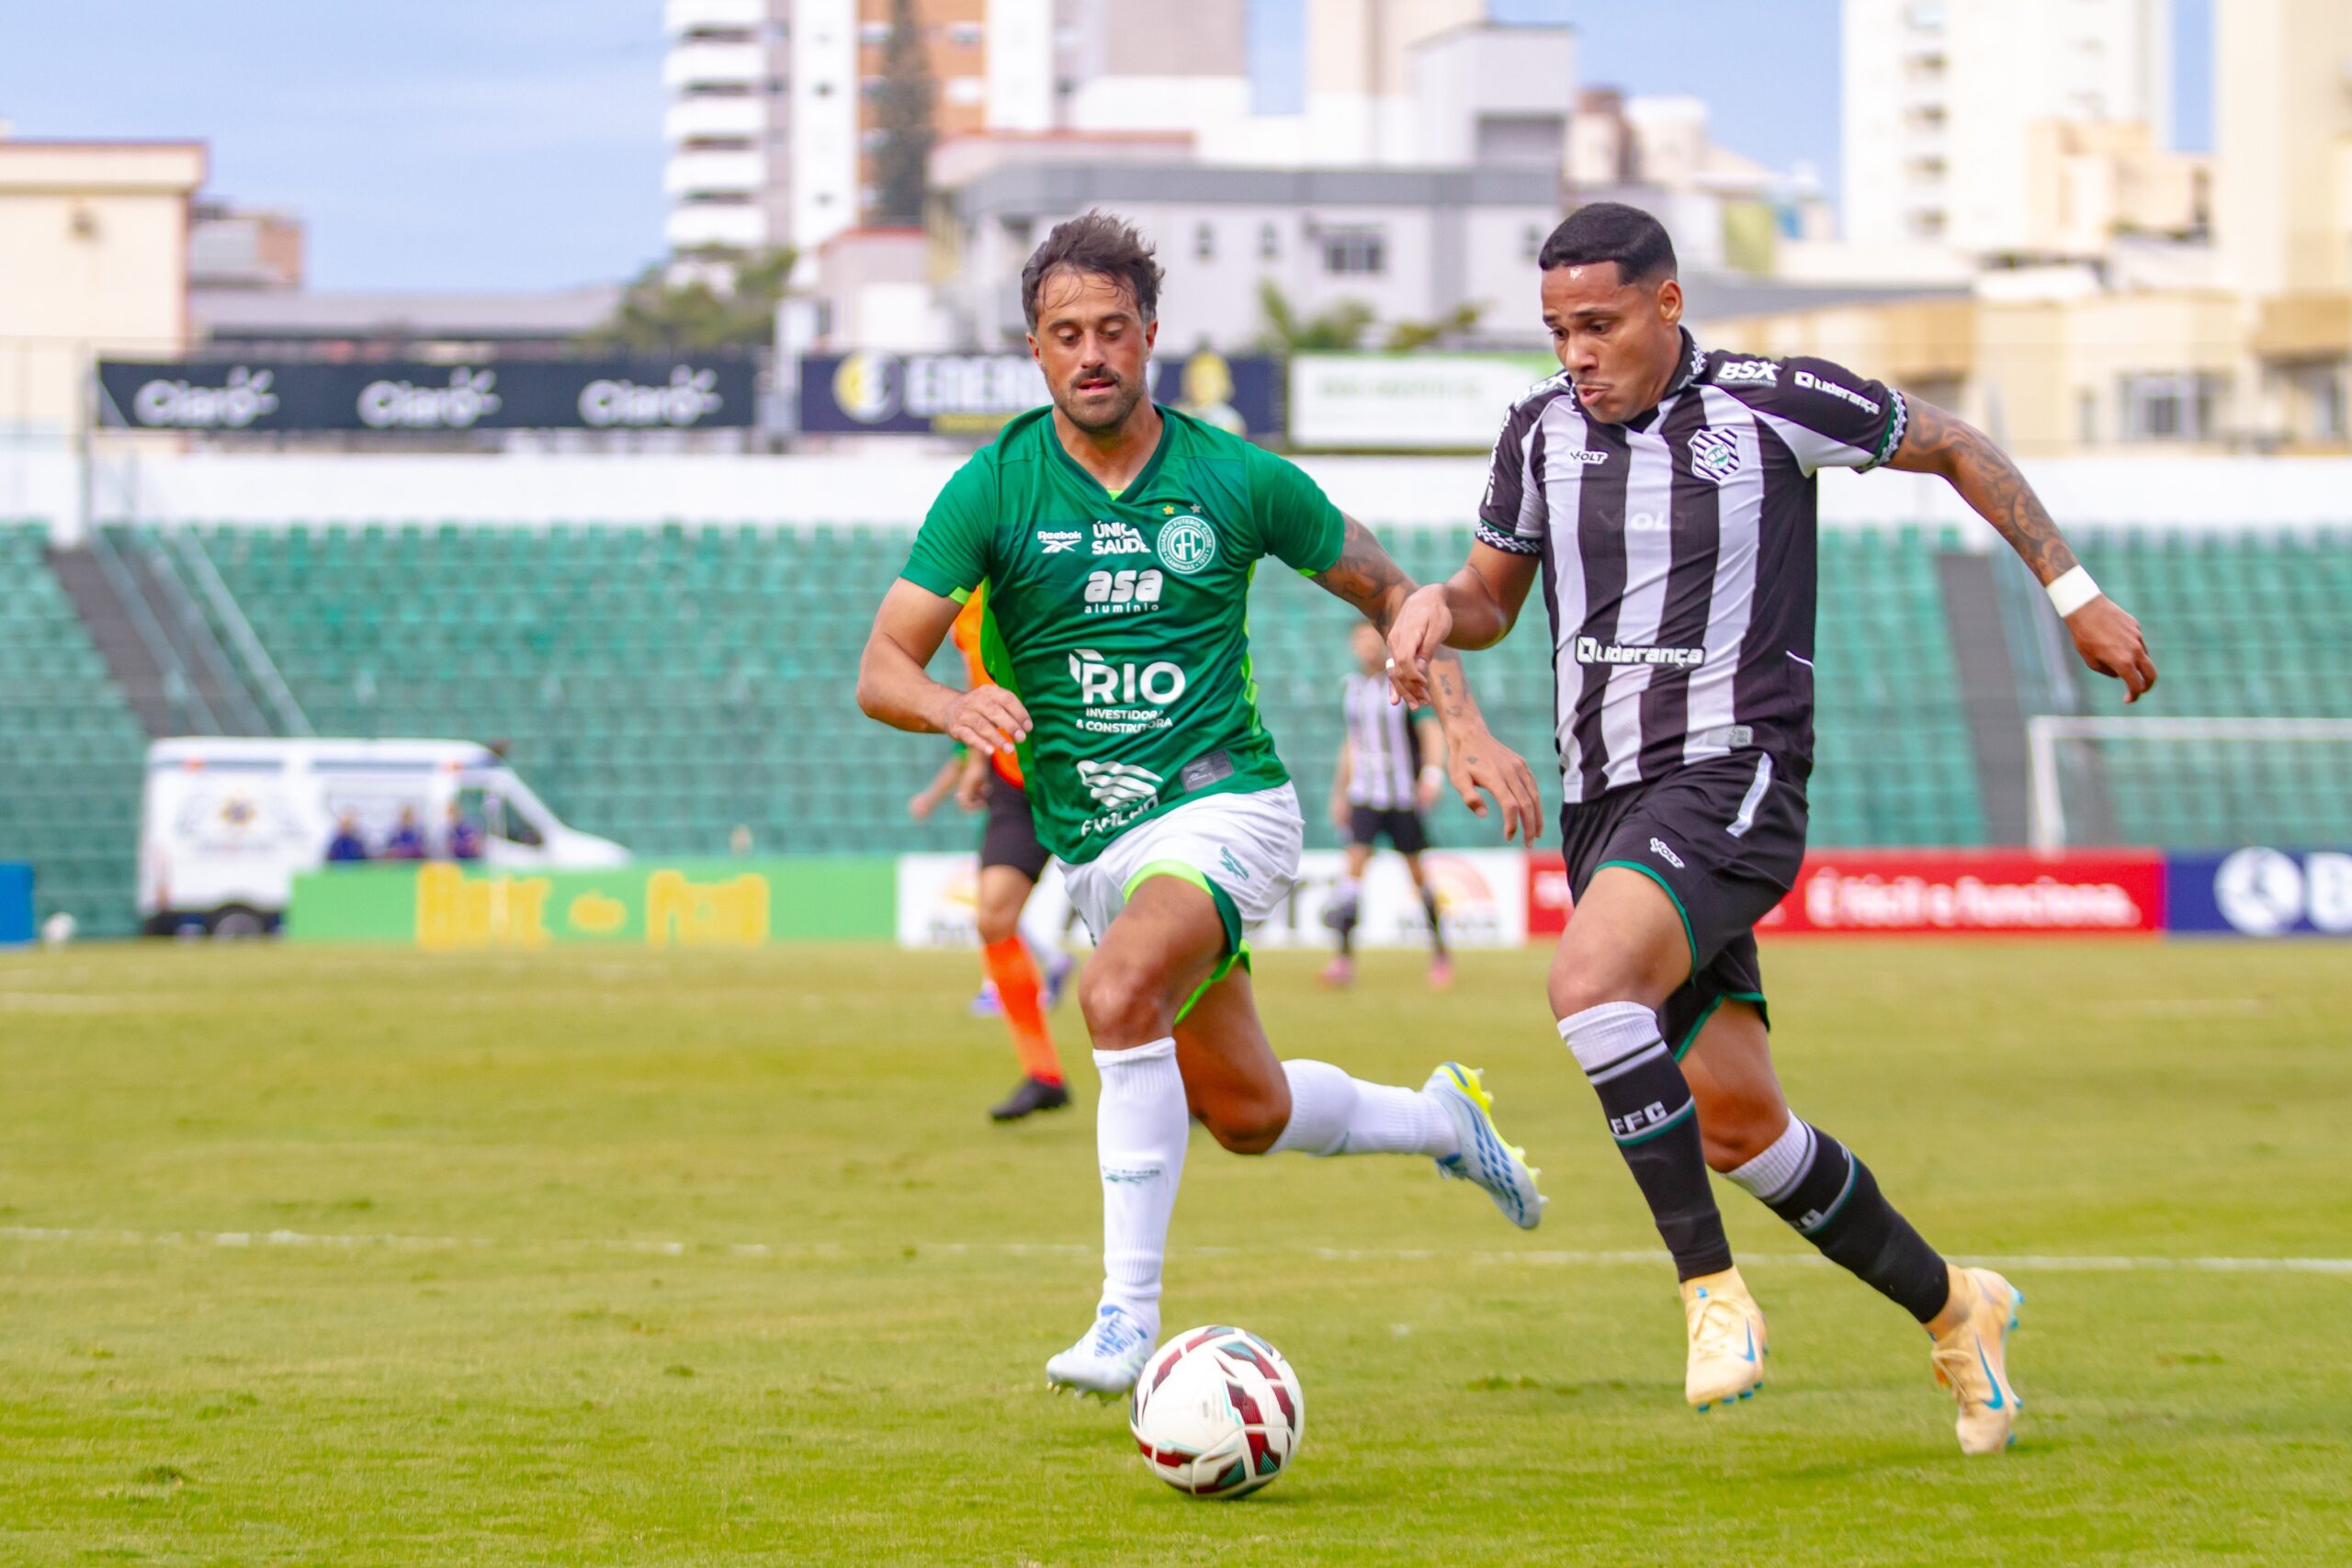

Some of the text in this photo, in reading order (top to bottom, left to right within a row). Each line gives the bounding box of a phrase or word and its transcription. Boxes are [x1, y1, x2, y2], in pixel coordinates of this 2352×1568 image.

[1717, 360, 1782, 381] BSX
[134, 377, 265, 427] Claro
[357, 377, 487, 427] Claro
[578, 377, 707, 427] Claro
[1569, 450, 1605, 463] VOLT
[1037, 531, 1081, 540] Reebok
[1084, 569, 1163, 603] asa
[1084, 603, 1159, 615] alumínio
[1080, 661, 1186, 705] RIO
[1076, 717, 1173, 734] & CONSTRUTORA
[1086, 707, 1164, 720] INVESTIDOR
[1611, 1100, 1668, 1135] FFC
